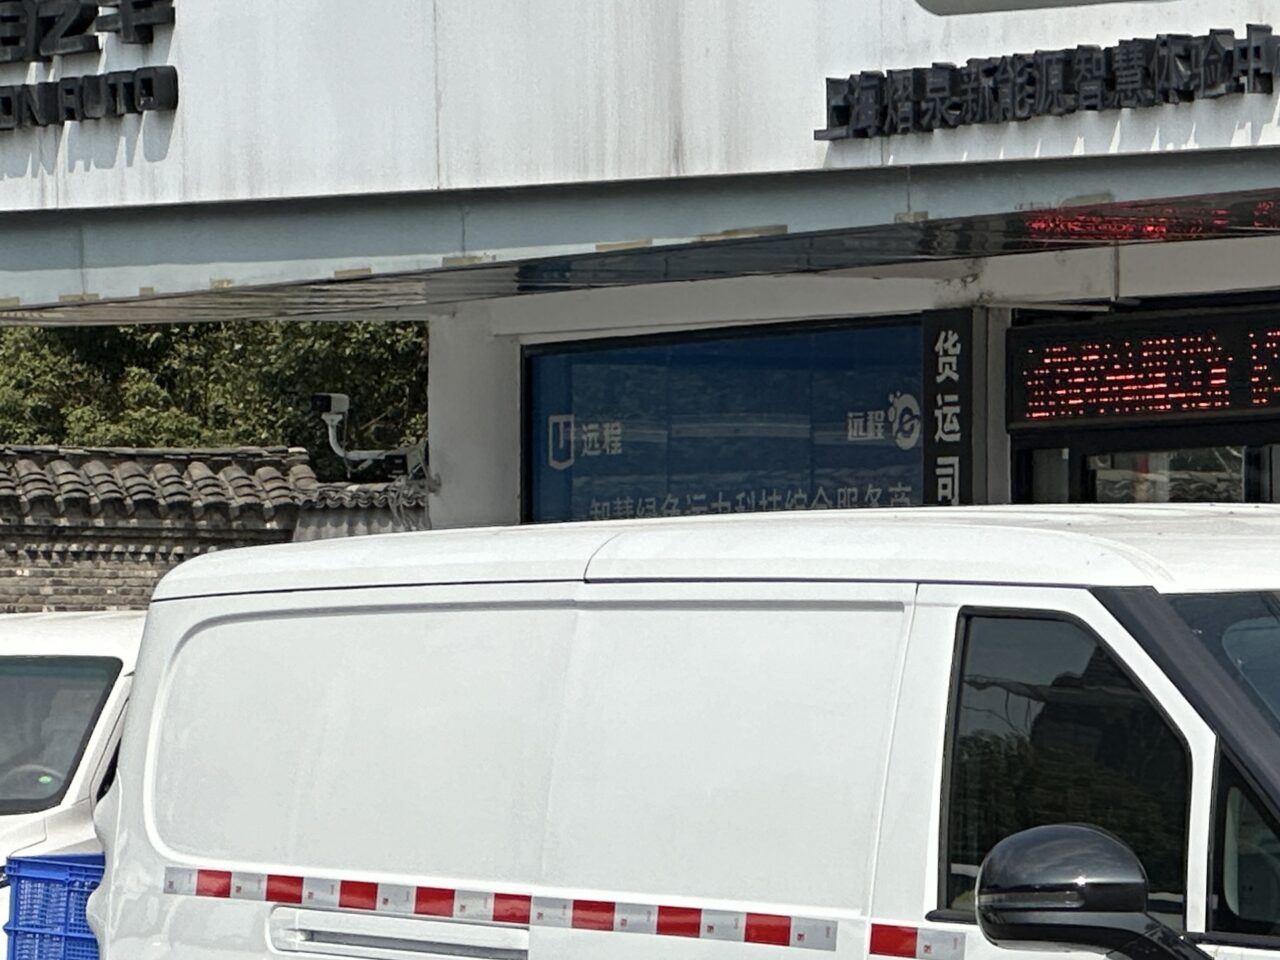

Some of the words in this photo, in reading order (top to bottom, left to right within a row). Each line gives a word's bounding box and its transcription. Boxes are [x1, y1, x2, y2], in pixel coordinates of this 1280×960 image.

[59, 65, 179, 122] AUTO
[581, 420, 624, 457] 远程
[847, 410, 886, 442] 远程
